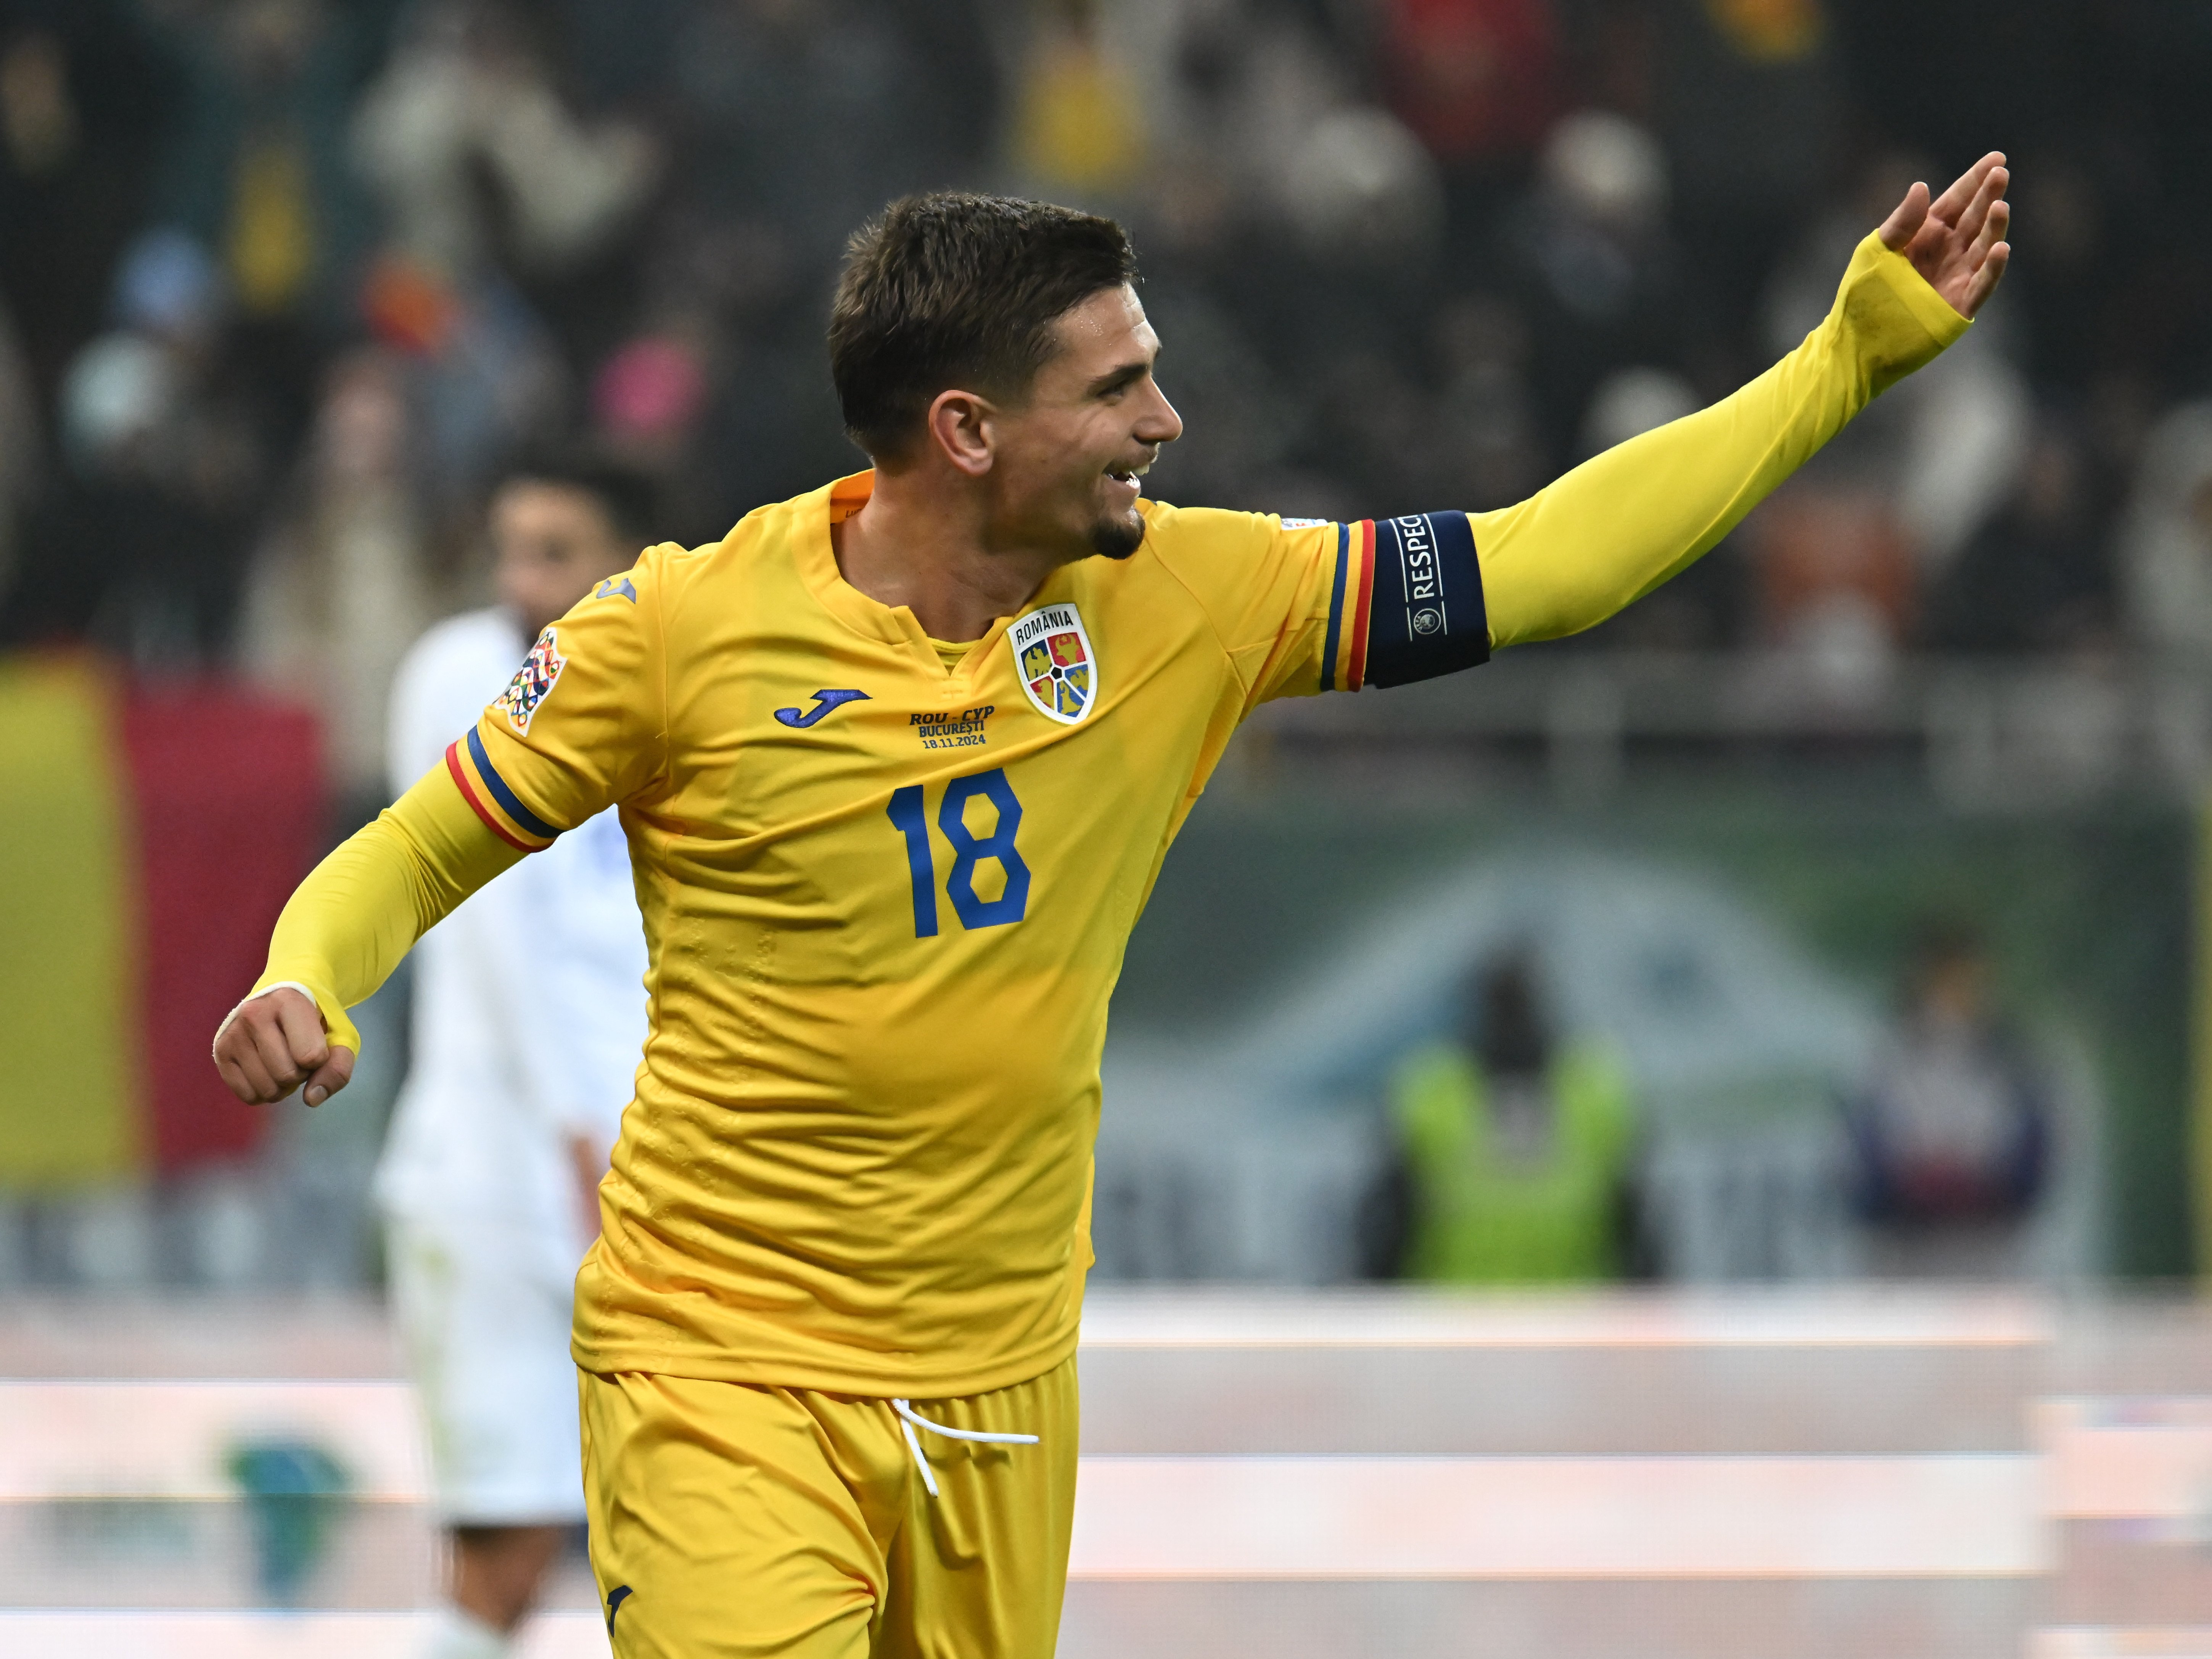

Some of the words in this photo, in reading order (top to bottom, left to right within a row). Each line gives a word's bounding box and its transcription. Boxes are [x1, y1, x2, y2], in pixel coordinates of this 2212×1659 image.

[1016, 611, 1073, 646] ROMÂNIA
[909, 712, 949, 725] ROU
[962, 705, 995, 722] CYP
[919, 720, 984, 738] BUCUREȘTI
[922, 734, 986, 749] 18.11.2024
[886, 767, 1031, 938] 18
